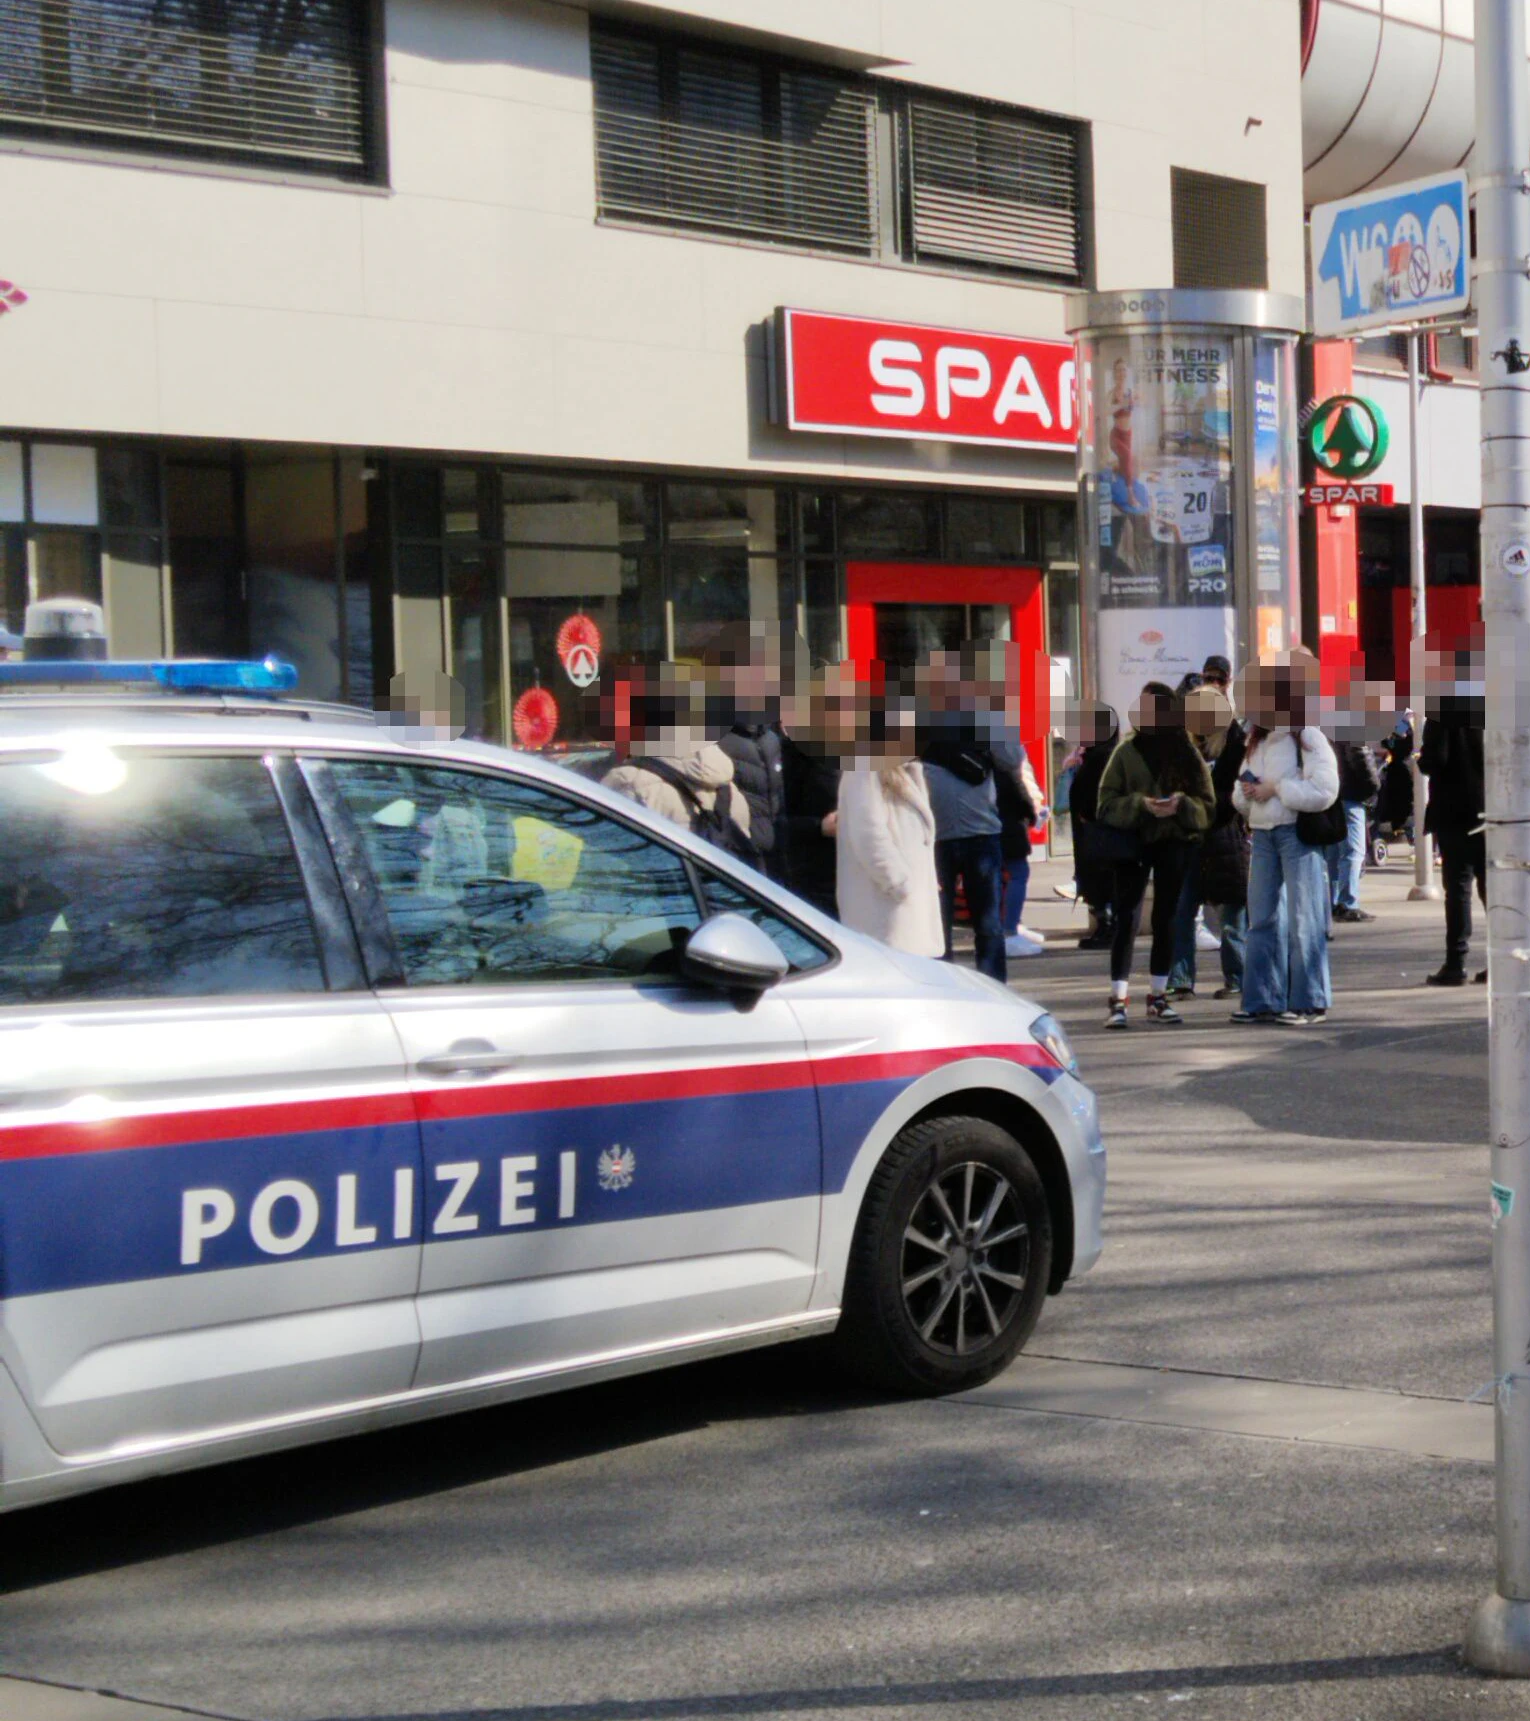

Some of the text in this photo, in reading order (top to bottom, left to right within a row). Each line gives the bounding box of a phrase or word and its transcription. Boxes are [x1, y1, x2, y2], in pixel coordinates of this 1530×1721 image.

[1172, 348, 1220, 361] MEHR
[1183, 491, 1207, 514] 20
[1309, 486, 1378, 503] SPAR
[1189, 579, 1226, 592] PRO
[180, 1150, 577, 1266] POLIZEI
